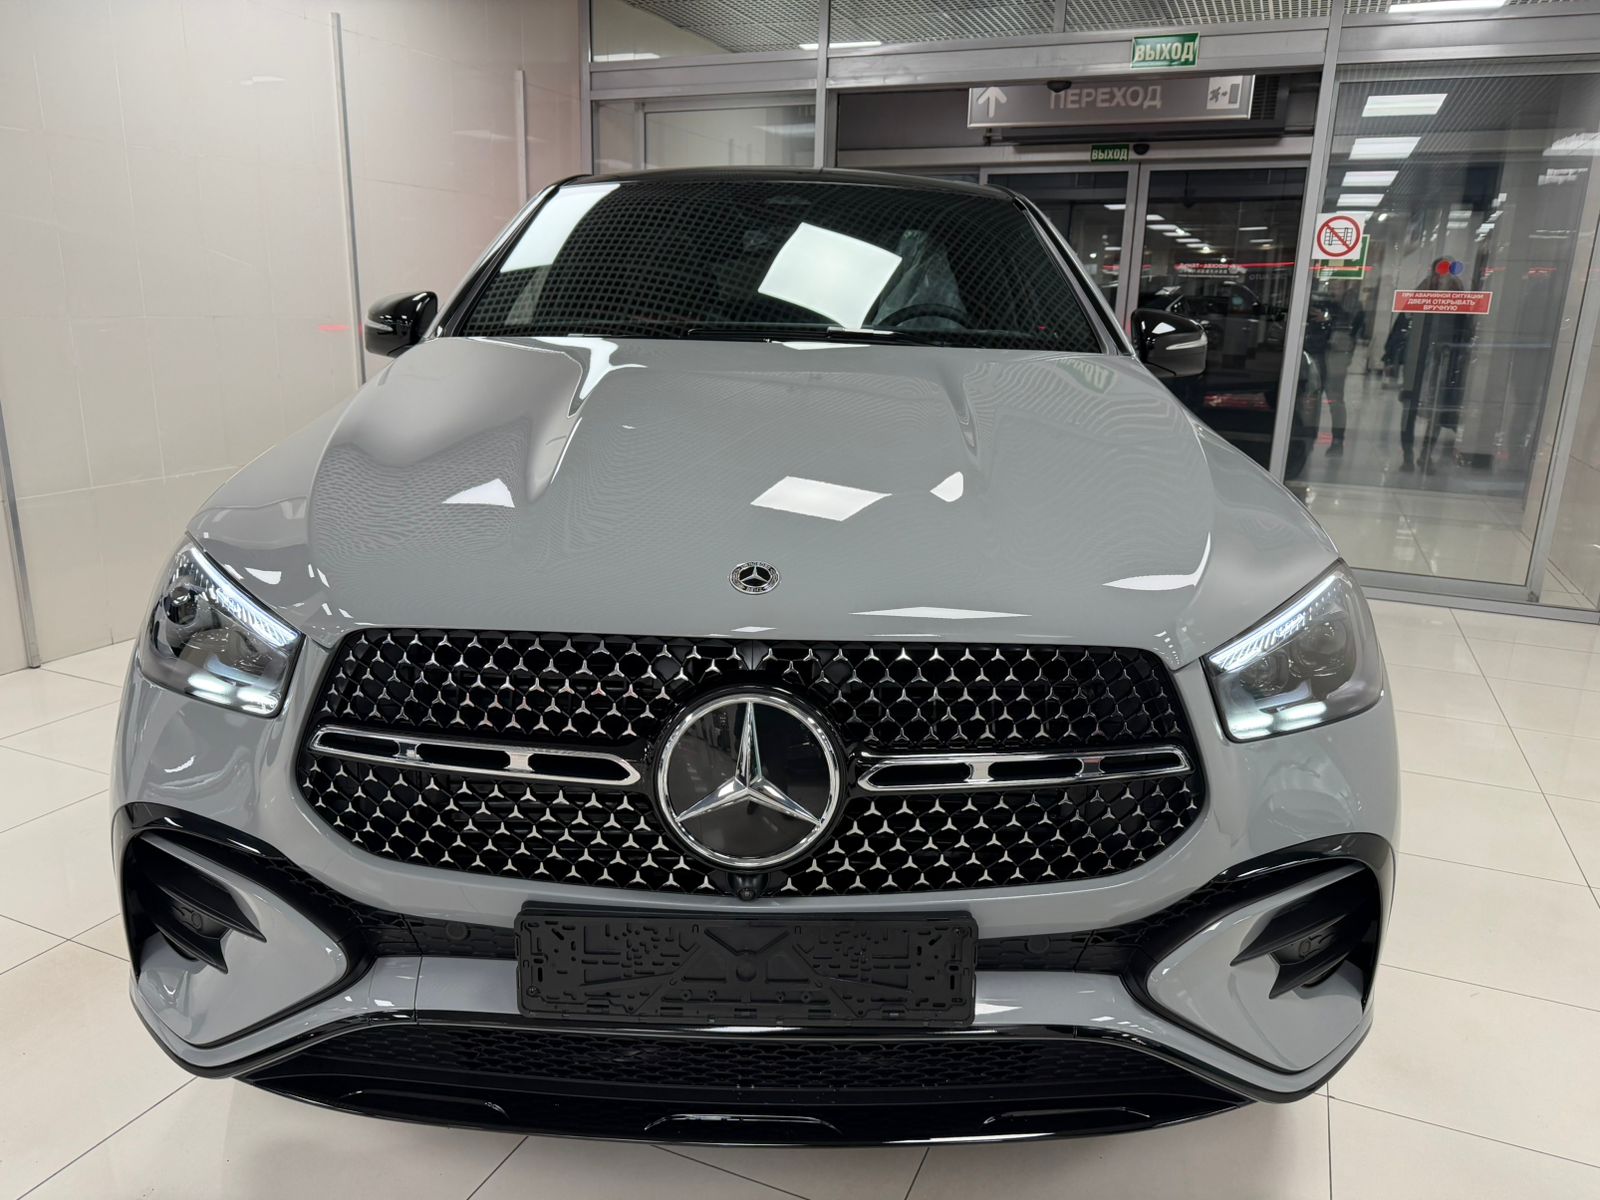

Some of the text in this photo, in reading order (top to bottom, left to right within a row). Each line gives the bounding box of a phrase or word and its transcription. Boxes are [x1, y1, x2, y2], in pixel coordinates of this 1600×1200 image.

[1135, 42, 1195, 62] ВЫХОД
[1050, 85, 1162, 109] ПЕРЕХОД
[1091, 148, 1128, 160] ВЫХОД
